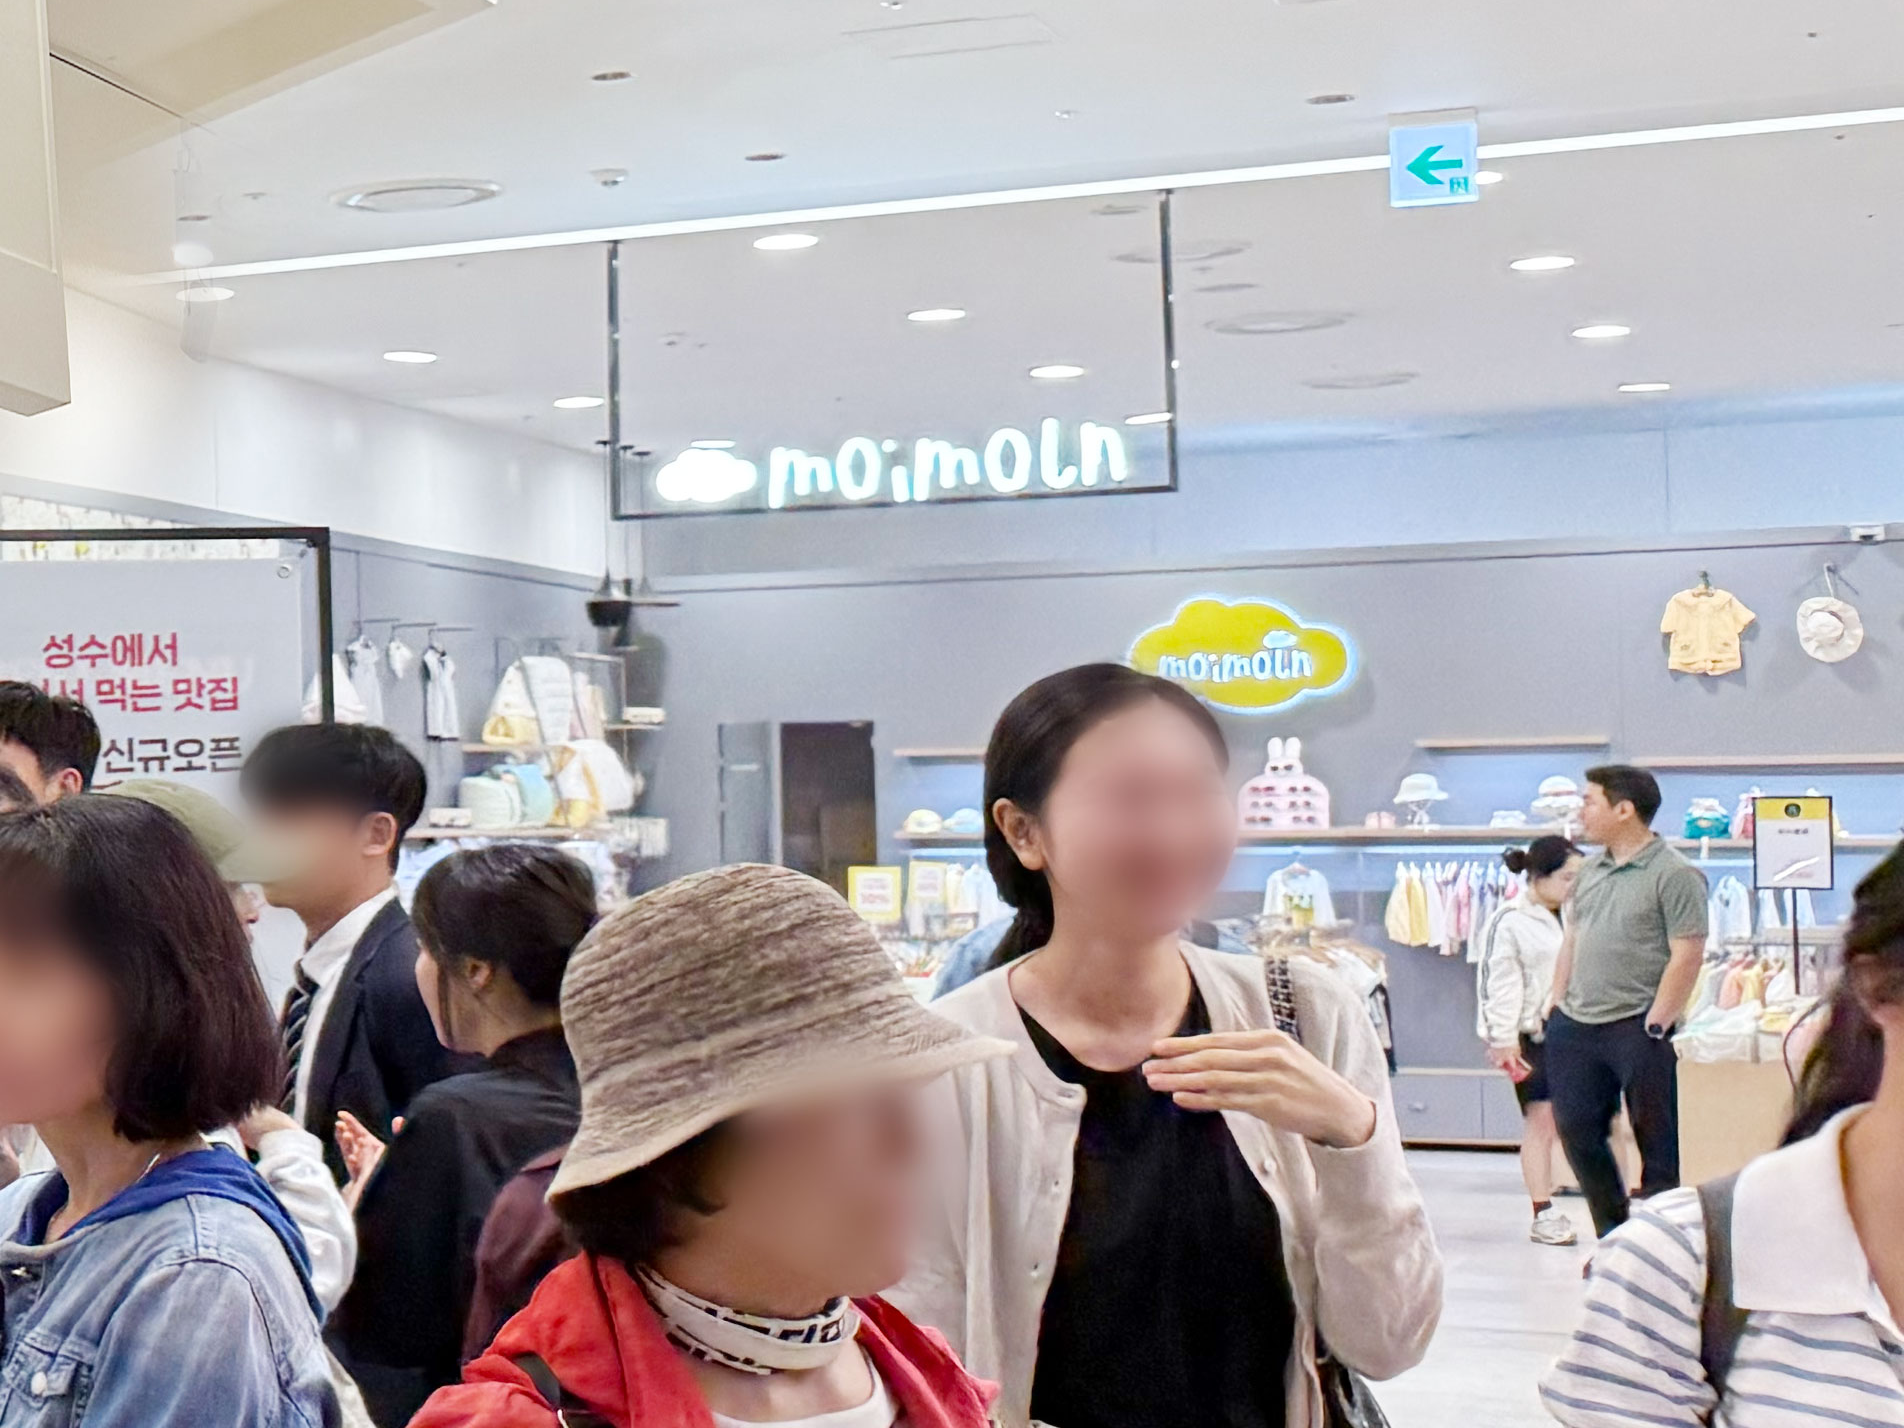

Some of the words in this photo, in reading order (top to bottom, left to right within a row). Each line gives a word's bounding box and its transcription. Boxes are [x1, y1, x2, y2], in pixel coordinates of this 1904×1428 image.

[42, 632, 179, 669] 성수에서
[95, 677, 163, 712] 먹는
[172, 676, 240, 712] 맛집
[102, 737, 242, 774] 신규오픈
